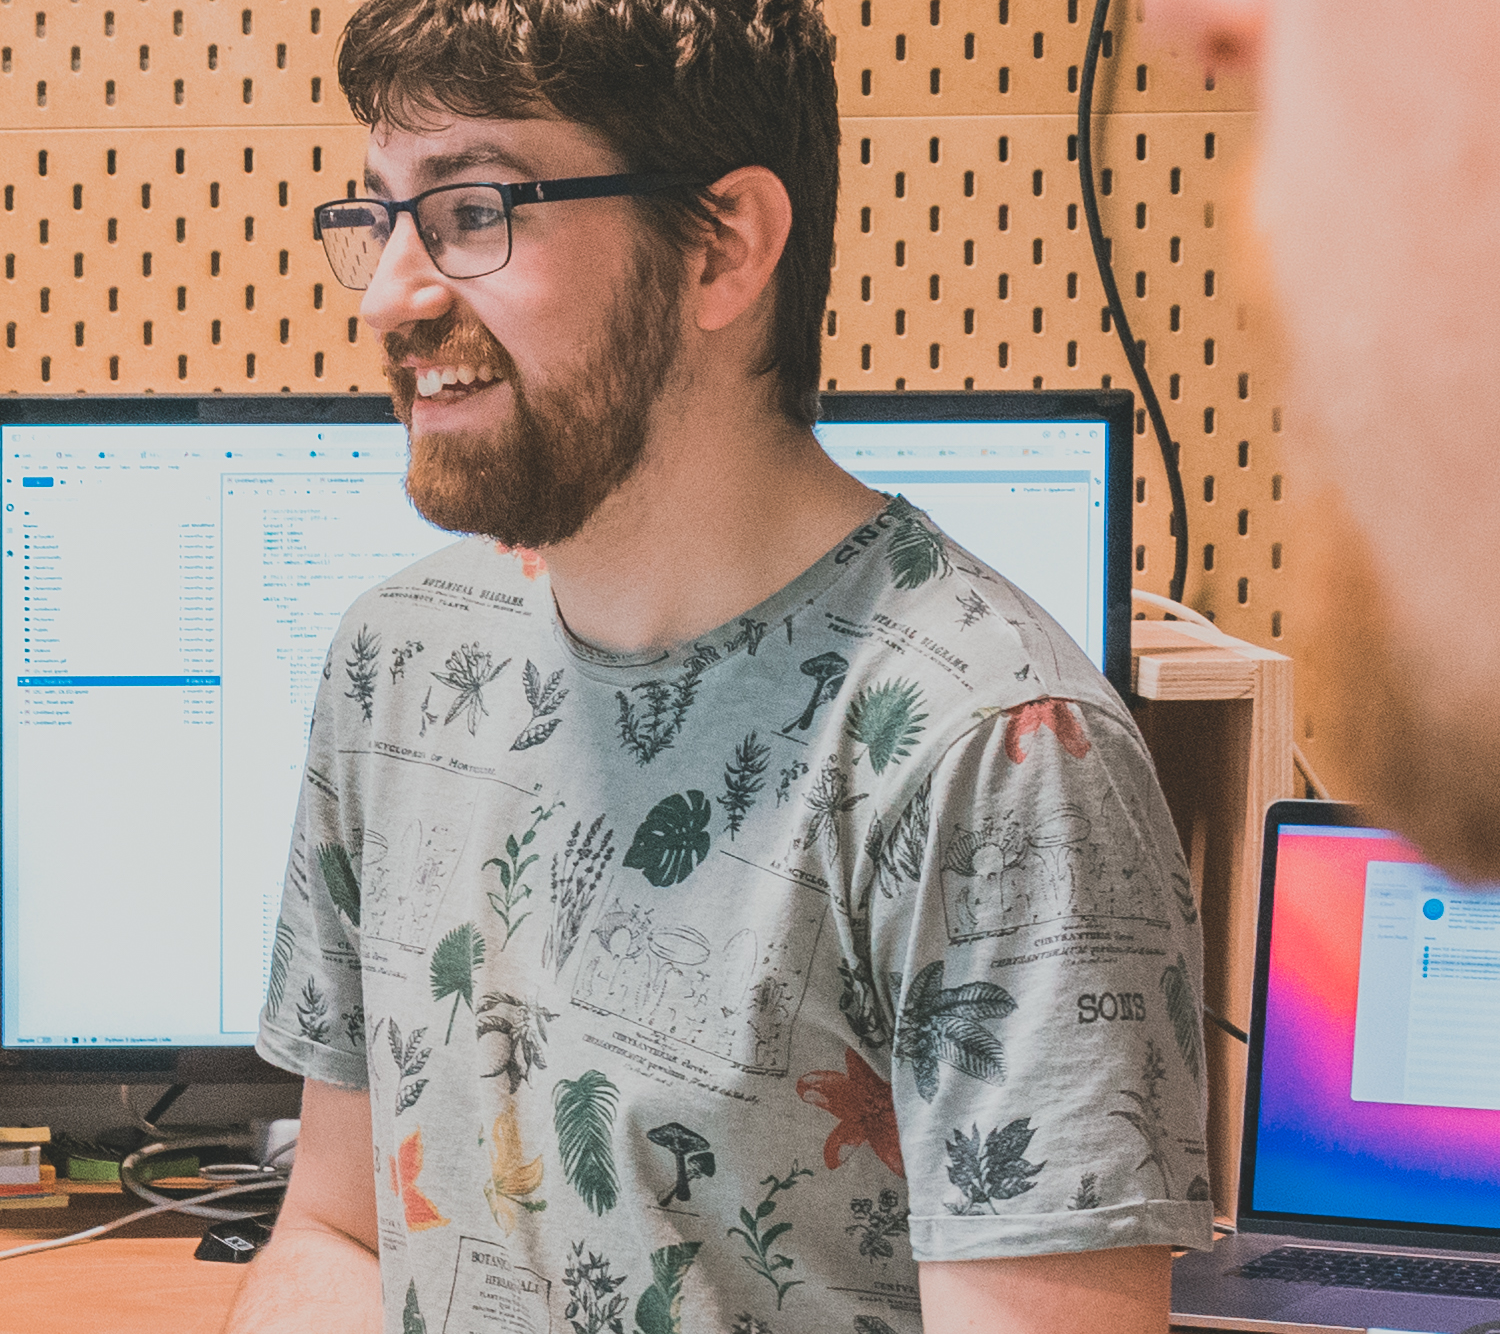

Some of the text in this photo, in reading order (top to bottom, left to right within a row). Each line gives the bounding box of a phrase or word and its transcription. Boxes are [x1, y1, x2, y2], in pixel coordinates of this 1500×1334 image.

[422, 577, 474, 596] BOTANICAL
[479, 589, 524, 607] DIAGRAMS
[1077, 992, 1147, 1025] SONS
